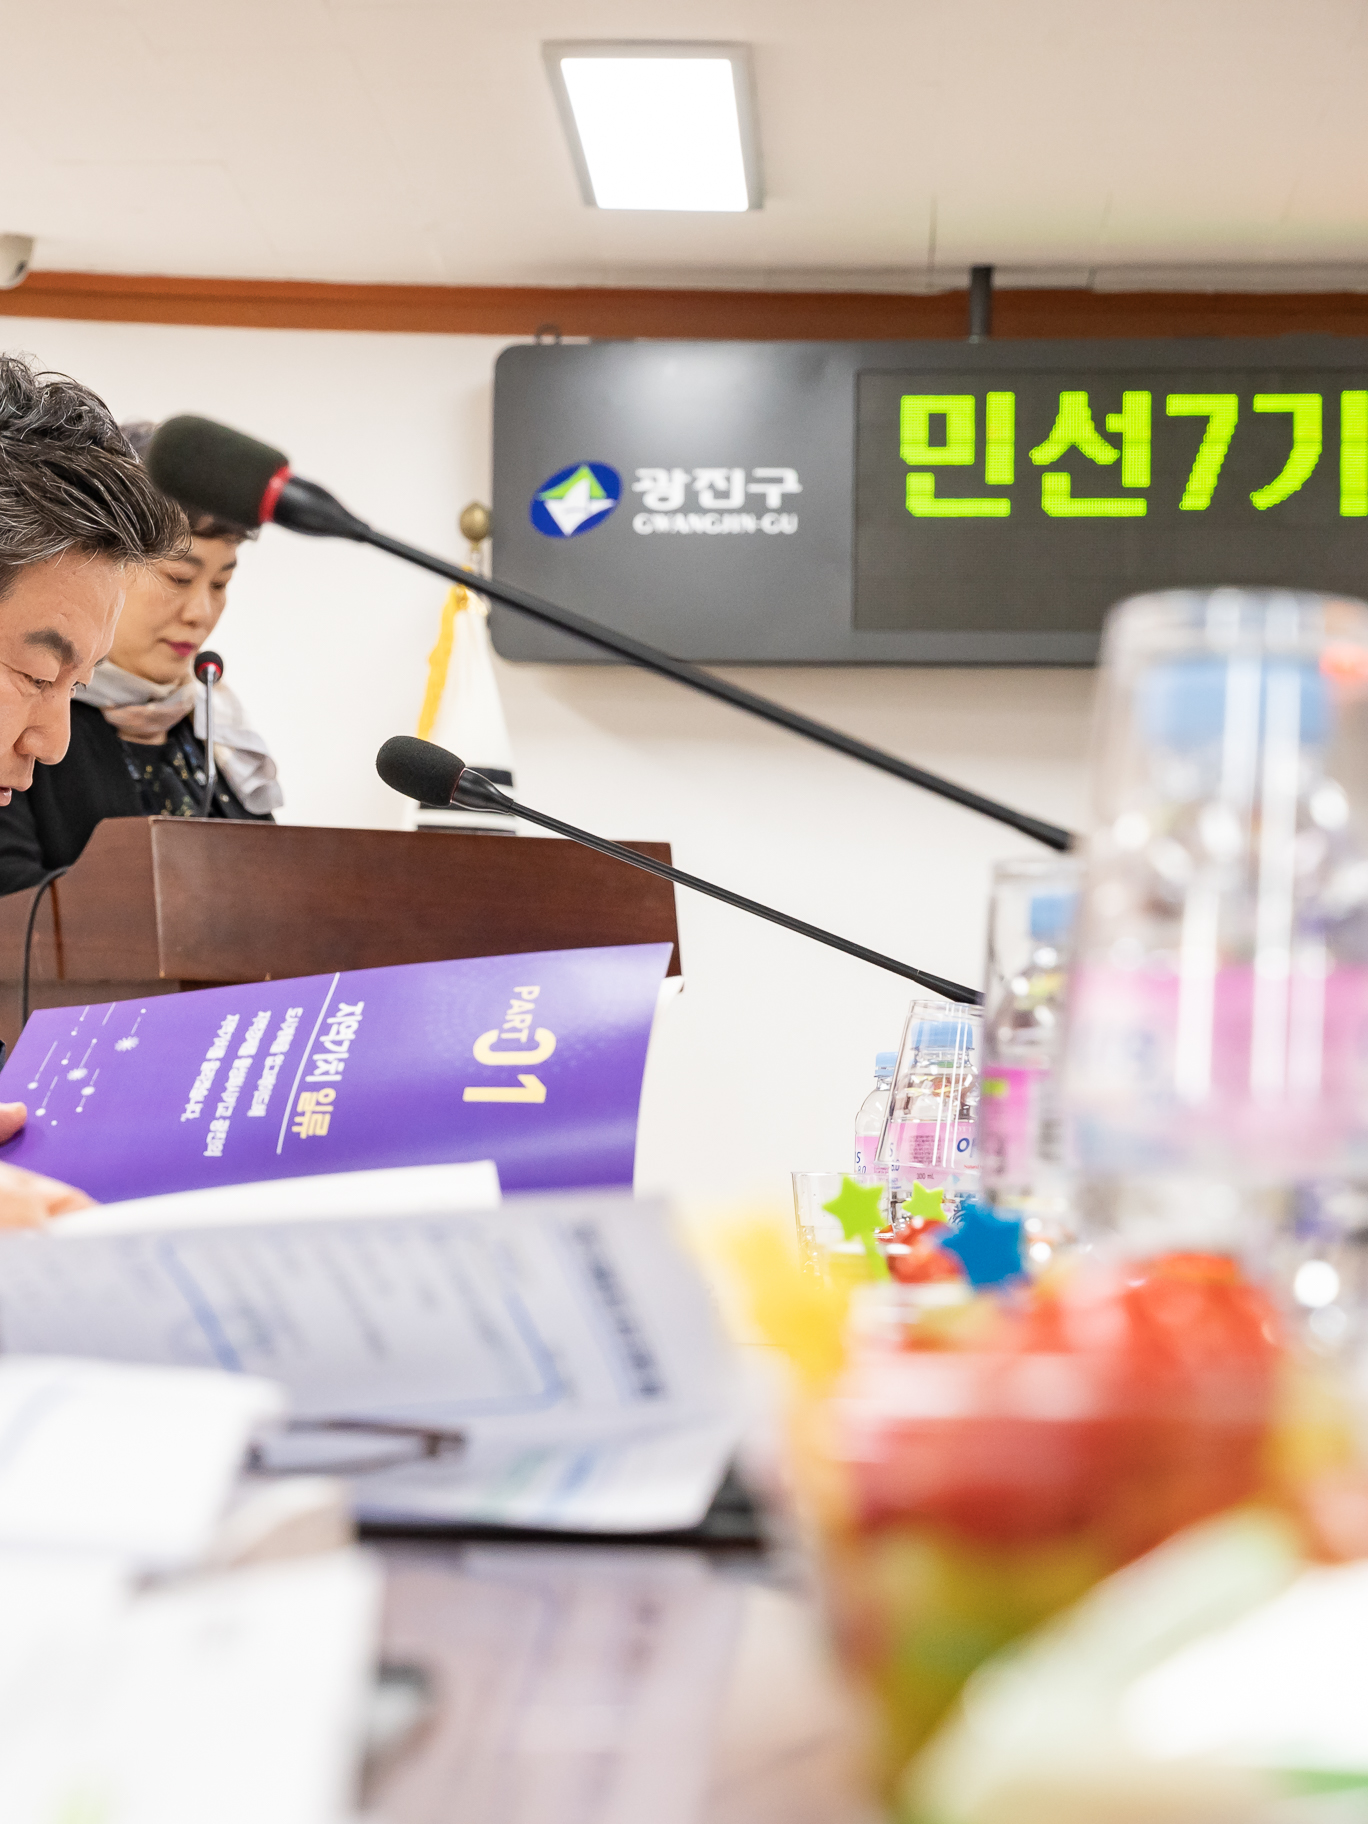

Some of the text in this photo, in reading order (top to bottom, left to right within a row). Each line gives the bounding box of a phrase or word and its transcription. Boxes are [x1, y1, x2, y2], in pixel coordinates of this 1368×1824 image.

[632, 467, 803, 511] 광진구
[632, 512, 799, 536] GWANGJIN-GU
[500, 985, 541, 1043] PART
[292, 1001, 364, 1139] 지역가치 일류
[462, 1027, 557, 1104] 01
